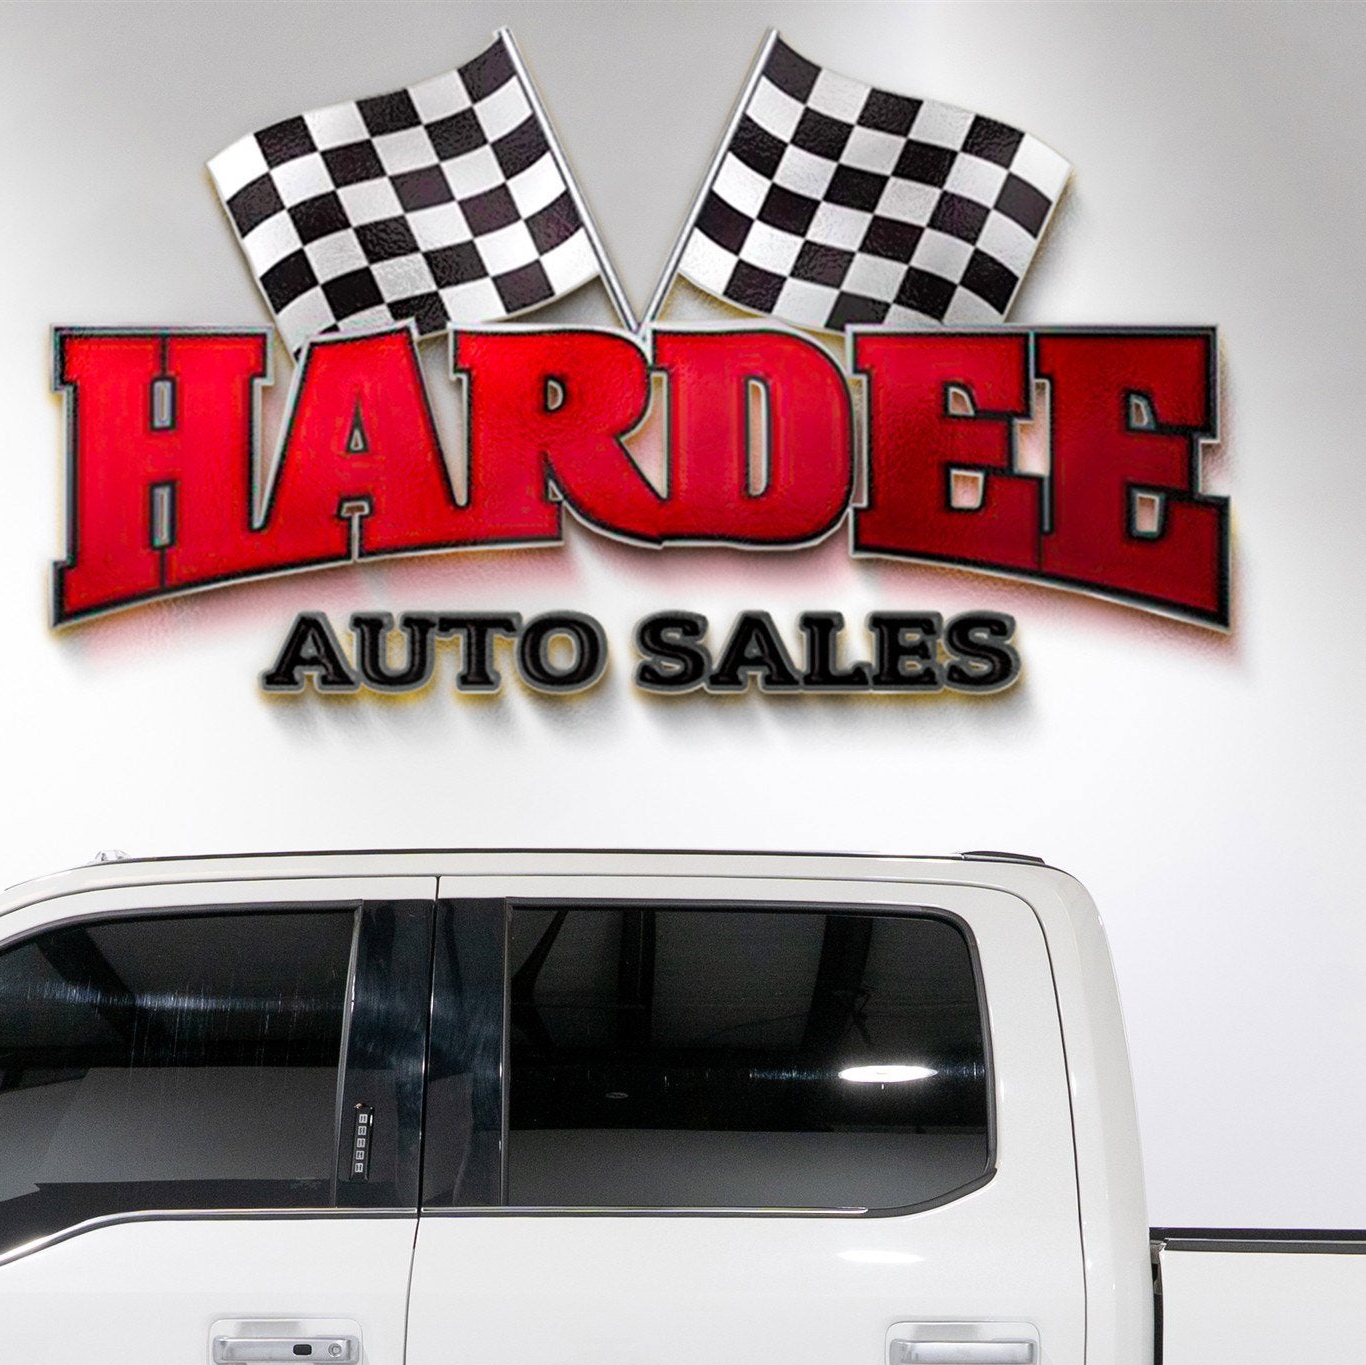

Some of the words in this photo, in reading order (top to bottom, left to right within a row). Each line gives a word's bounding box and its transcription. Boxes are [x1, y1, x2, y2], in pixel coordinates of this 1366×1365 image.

[51, 324, 1233, 632] HARDEE
[261, 610, 605, 692] AUTO
[635, 610, 1021, 692] SALES
